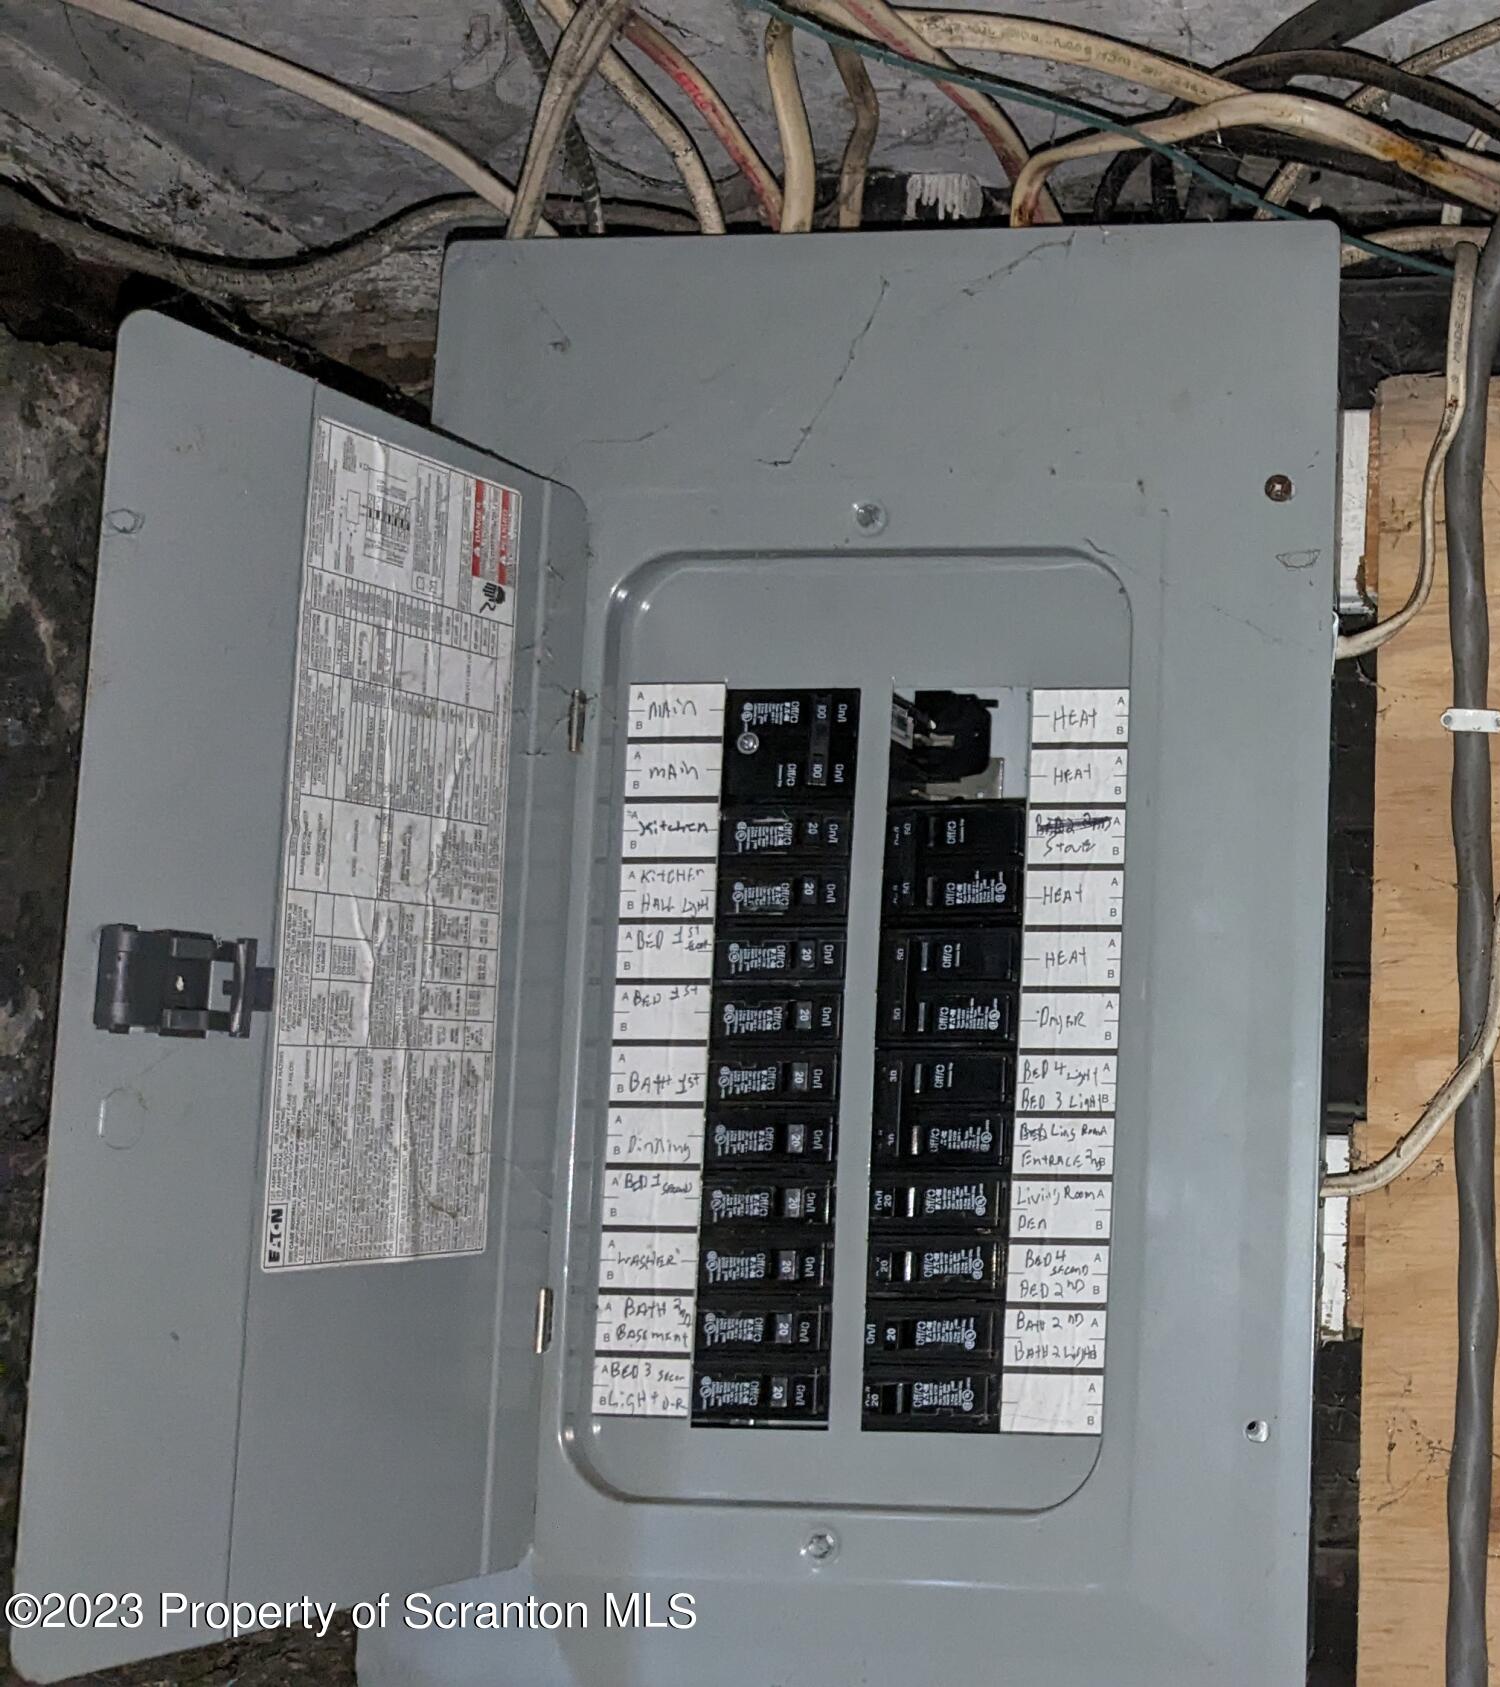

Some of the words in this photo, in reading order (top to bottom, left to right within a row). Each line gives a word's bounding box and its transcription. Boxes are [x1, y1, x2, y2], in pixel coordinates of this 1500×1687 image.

[812, 764, 823, 778] 100
[791, 1134, 801, 1147] 20
[779, 1322, 789, 1336] 20
